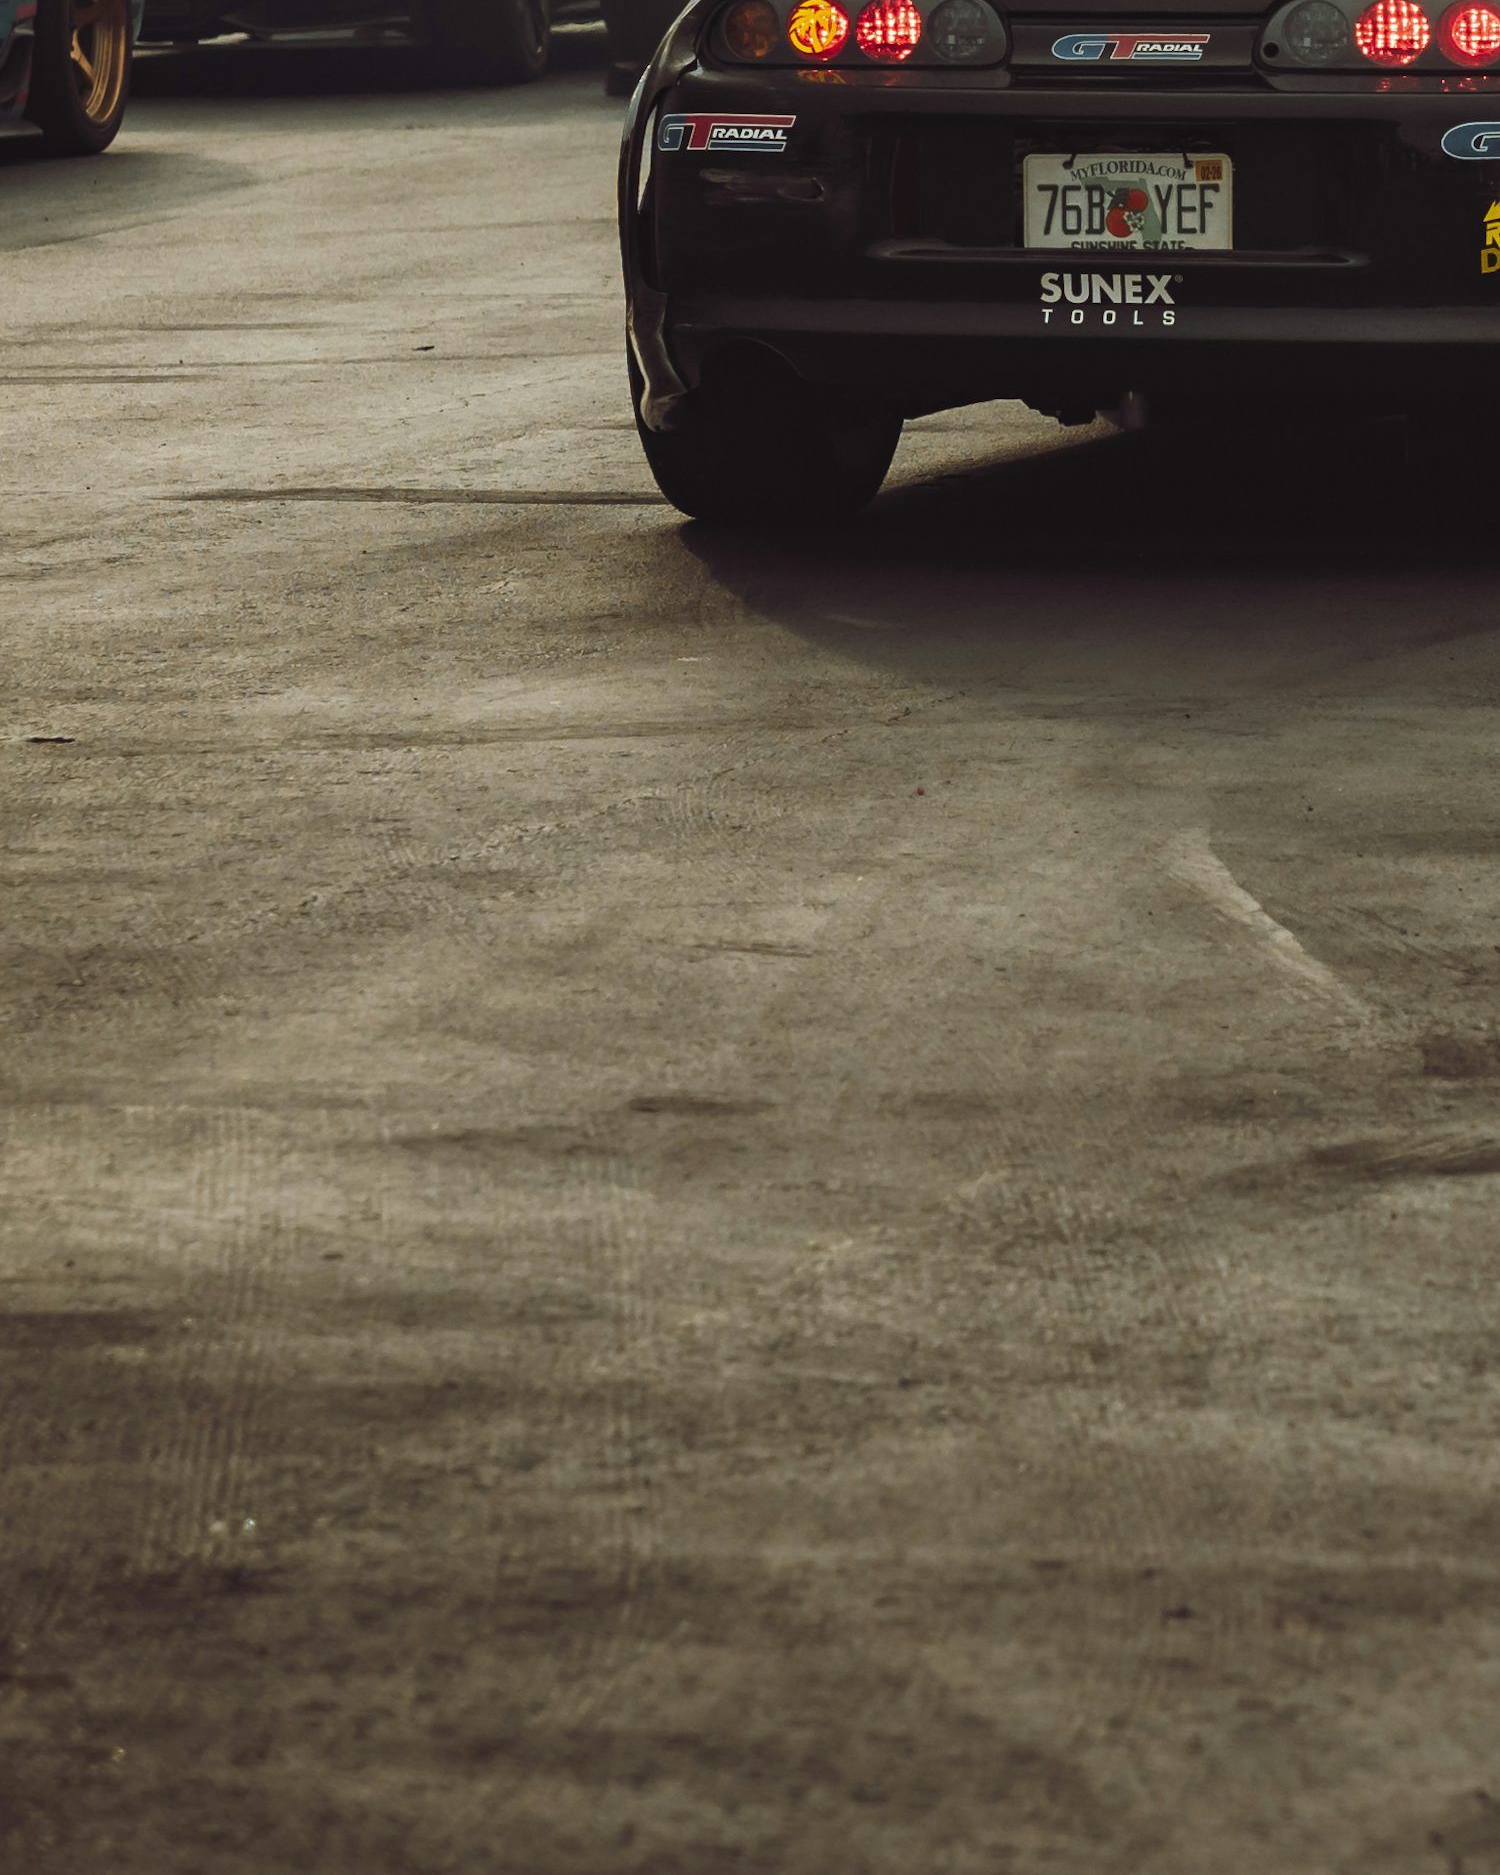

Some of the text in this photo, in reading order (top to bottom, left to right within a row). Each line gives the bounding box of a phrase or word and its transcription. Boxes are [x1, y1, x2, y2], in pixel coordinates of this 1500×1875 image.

[1051, 33, 1204, 61] GT RADIAL
[711, 127, 788, 141] RADIAL
[1036, 183, 1221, 236] 76B YEF
[1041, 308, 1176, 326] TOOLS
